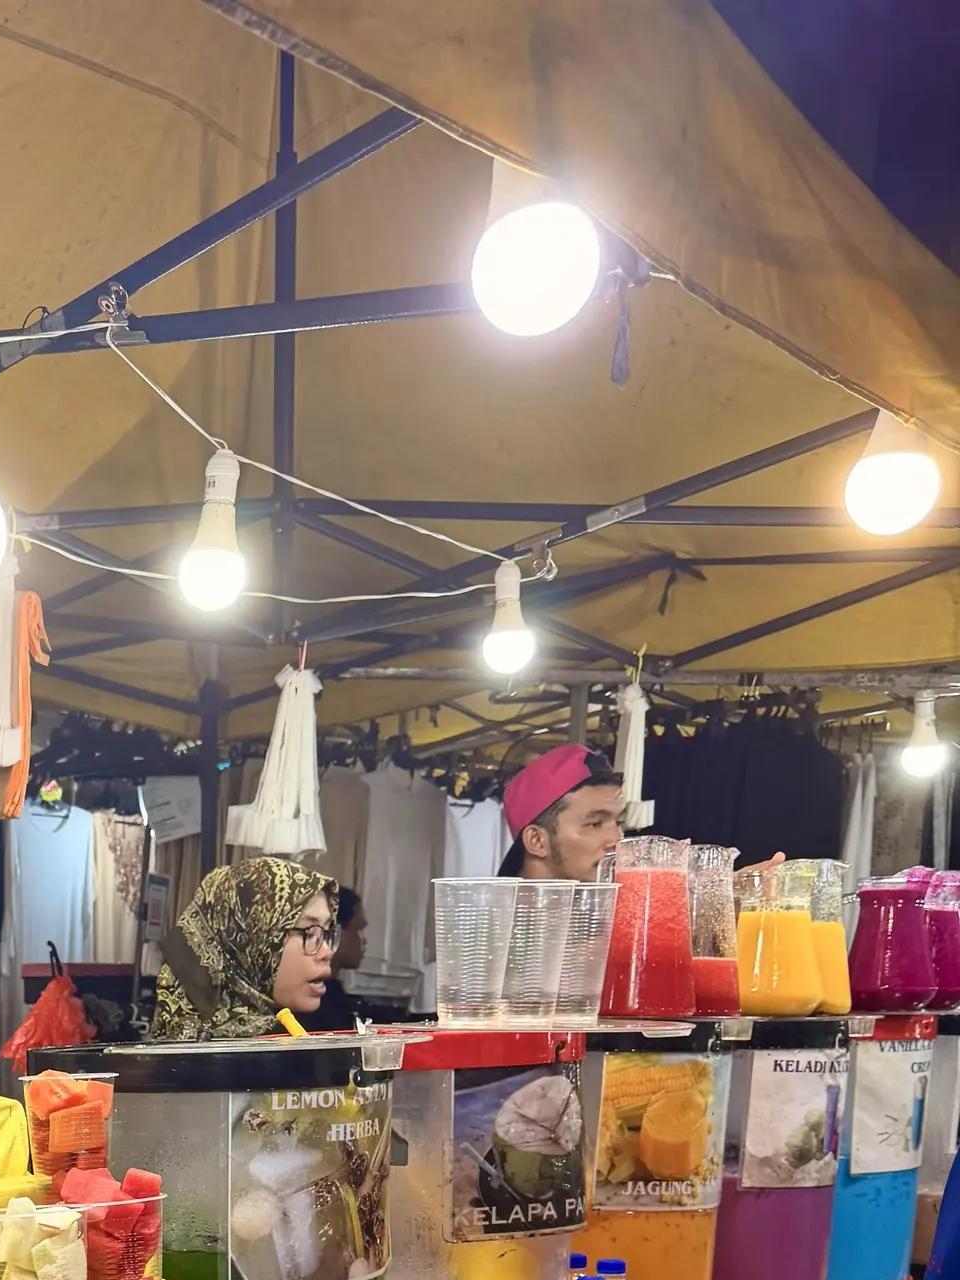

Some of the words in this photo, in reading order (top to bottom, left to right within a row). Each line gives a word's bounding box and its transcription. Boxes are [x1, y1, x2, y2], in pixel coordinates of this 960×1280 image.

[773, 1059, 826, 1074] KELADI
[271, 1089, 347, 1111] LEMON
[327, 1118, 381, 1142] HERBA
[622, 1180, 692, 1196] JAGUNG
[454, 1201, 558, 1226] KELAPA
